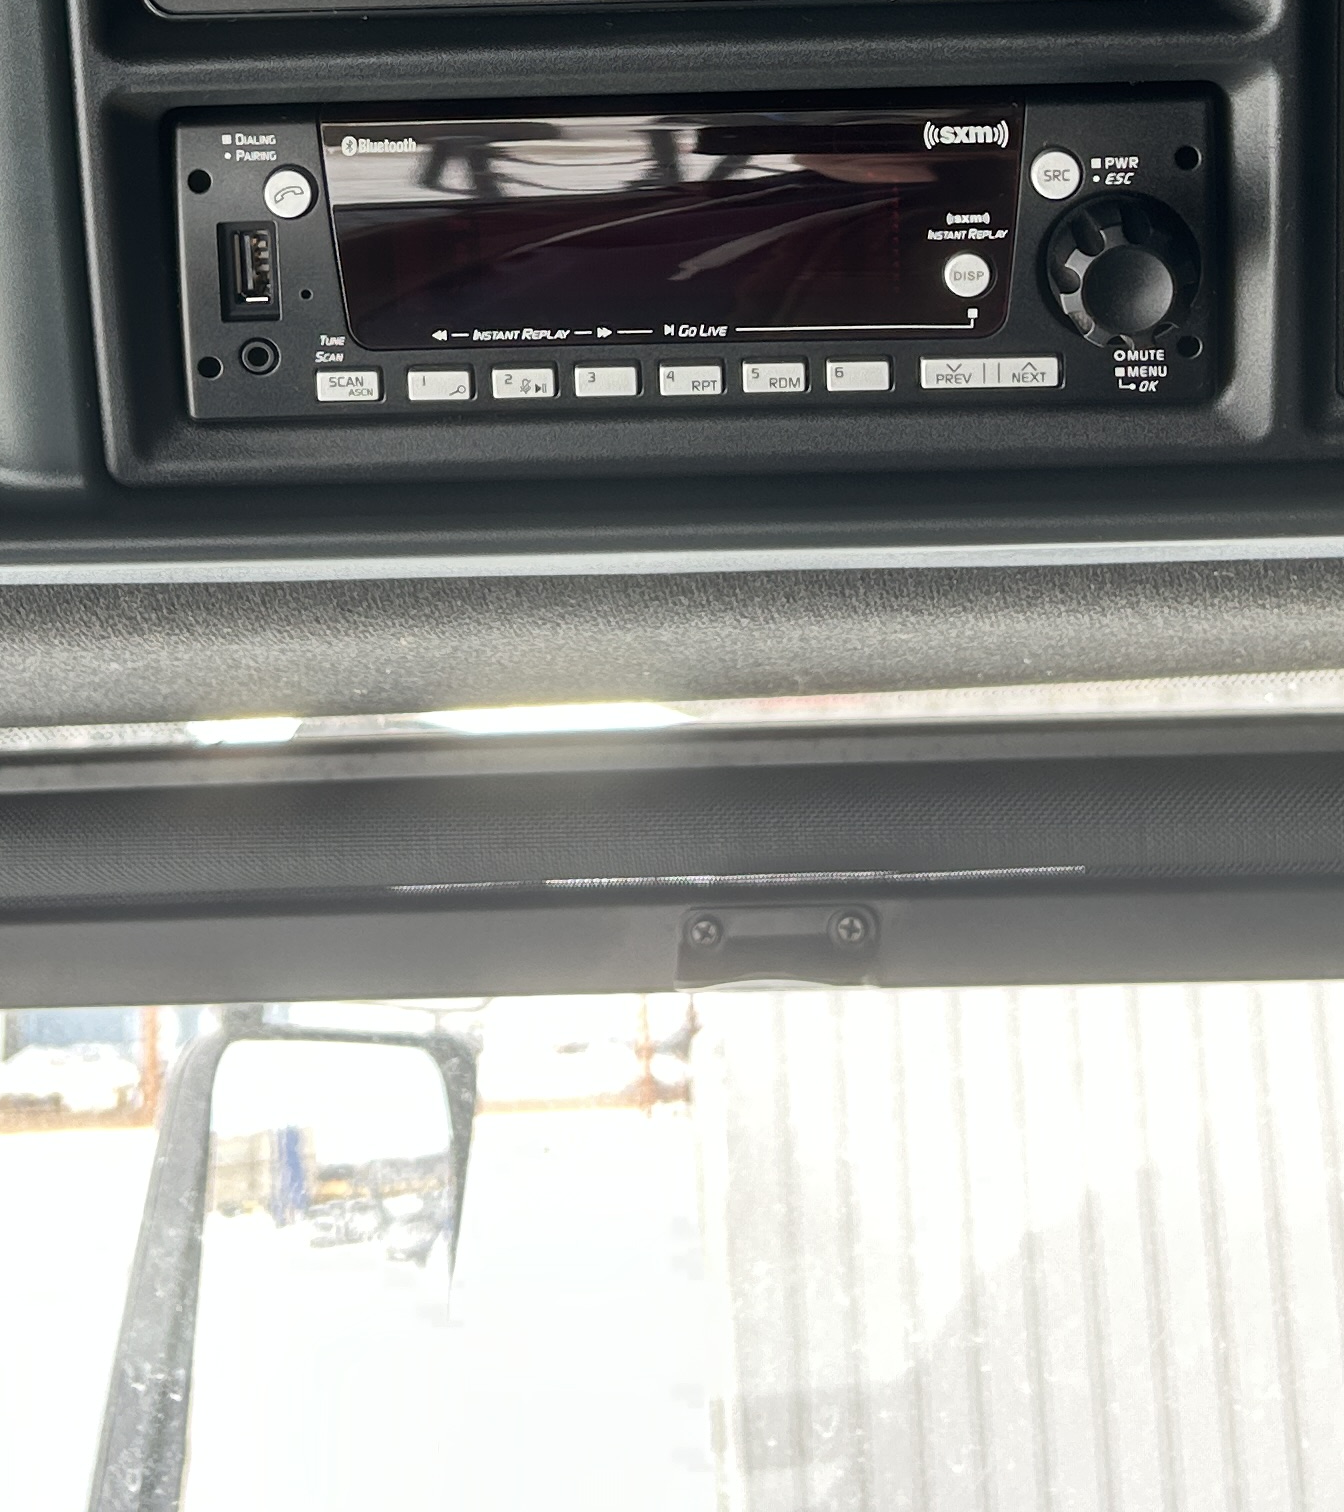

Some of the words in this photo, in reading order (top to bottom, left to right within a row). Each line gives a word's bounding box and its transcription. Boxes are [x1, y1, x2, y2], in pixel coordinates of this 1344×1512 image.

[358, 137, 417, 154] Bluetooth
[1105, 156, 1139, 169] PWR
[1043, 169, 1070, 182] SRC
[1105, 172, 1135, 185] ESC
[953, 271, 985, 281] DISP
[1127, 350, 1165, 361] MUTE
[666, 370, 675, 382] 4
[751, 368, 760, 379] 5
[835, 367, 844, 378] 6
[1127, 366, 1168, 377] MENU
[329, 377, 364, 387] SCAN
[505, 374, 513, 385] 2
[588, 372, 596, 383] 3
[936, 372, 973, 384] PREV
[1011, 372, 1047, 383] NEXT
[692, 380, 718, 392] RPT
[769, 378, 801, 389] RDM
[1138, 381, 1159, 392] OK
[348, 388, 374, 397] ASCN
